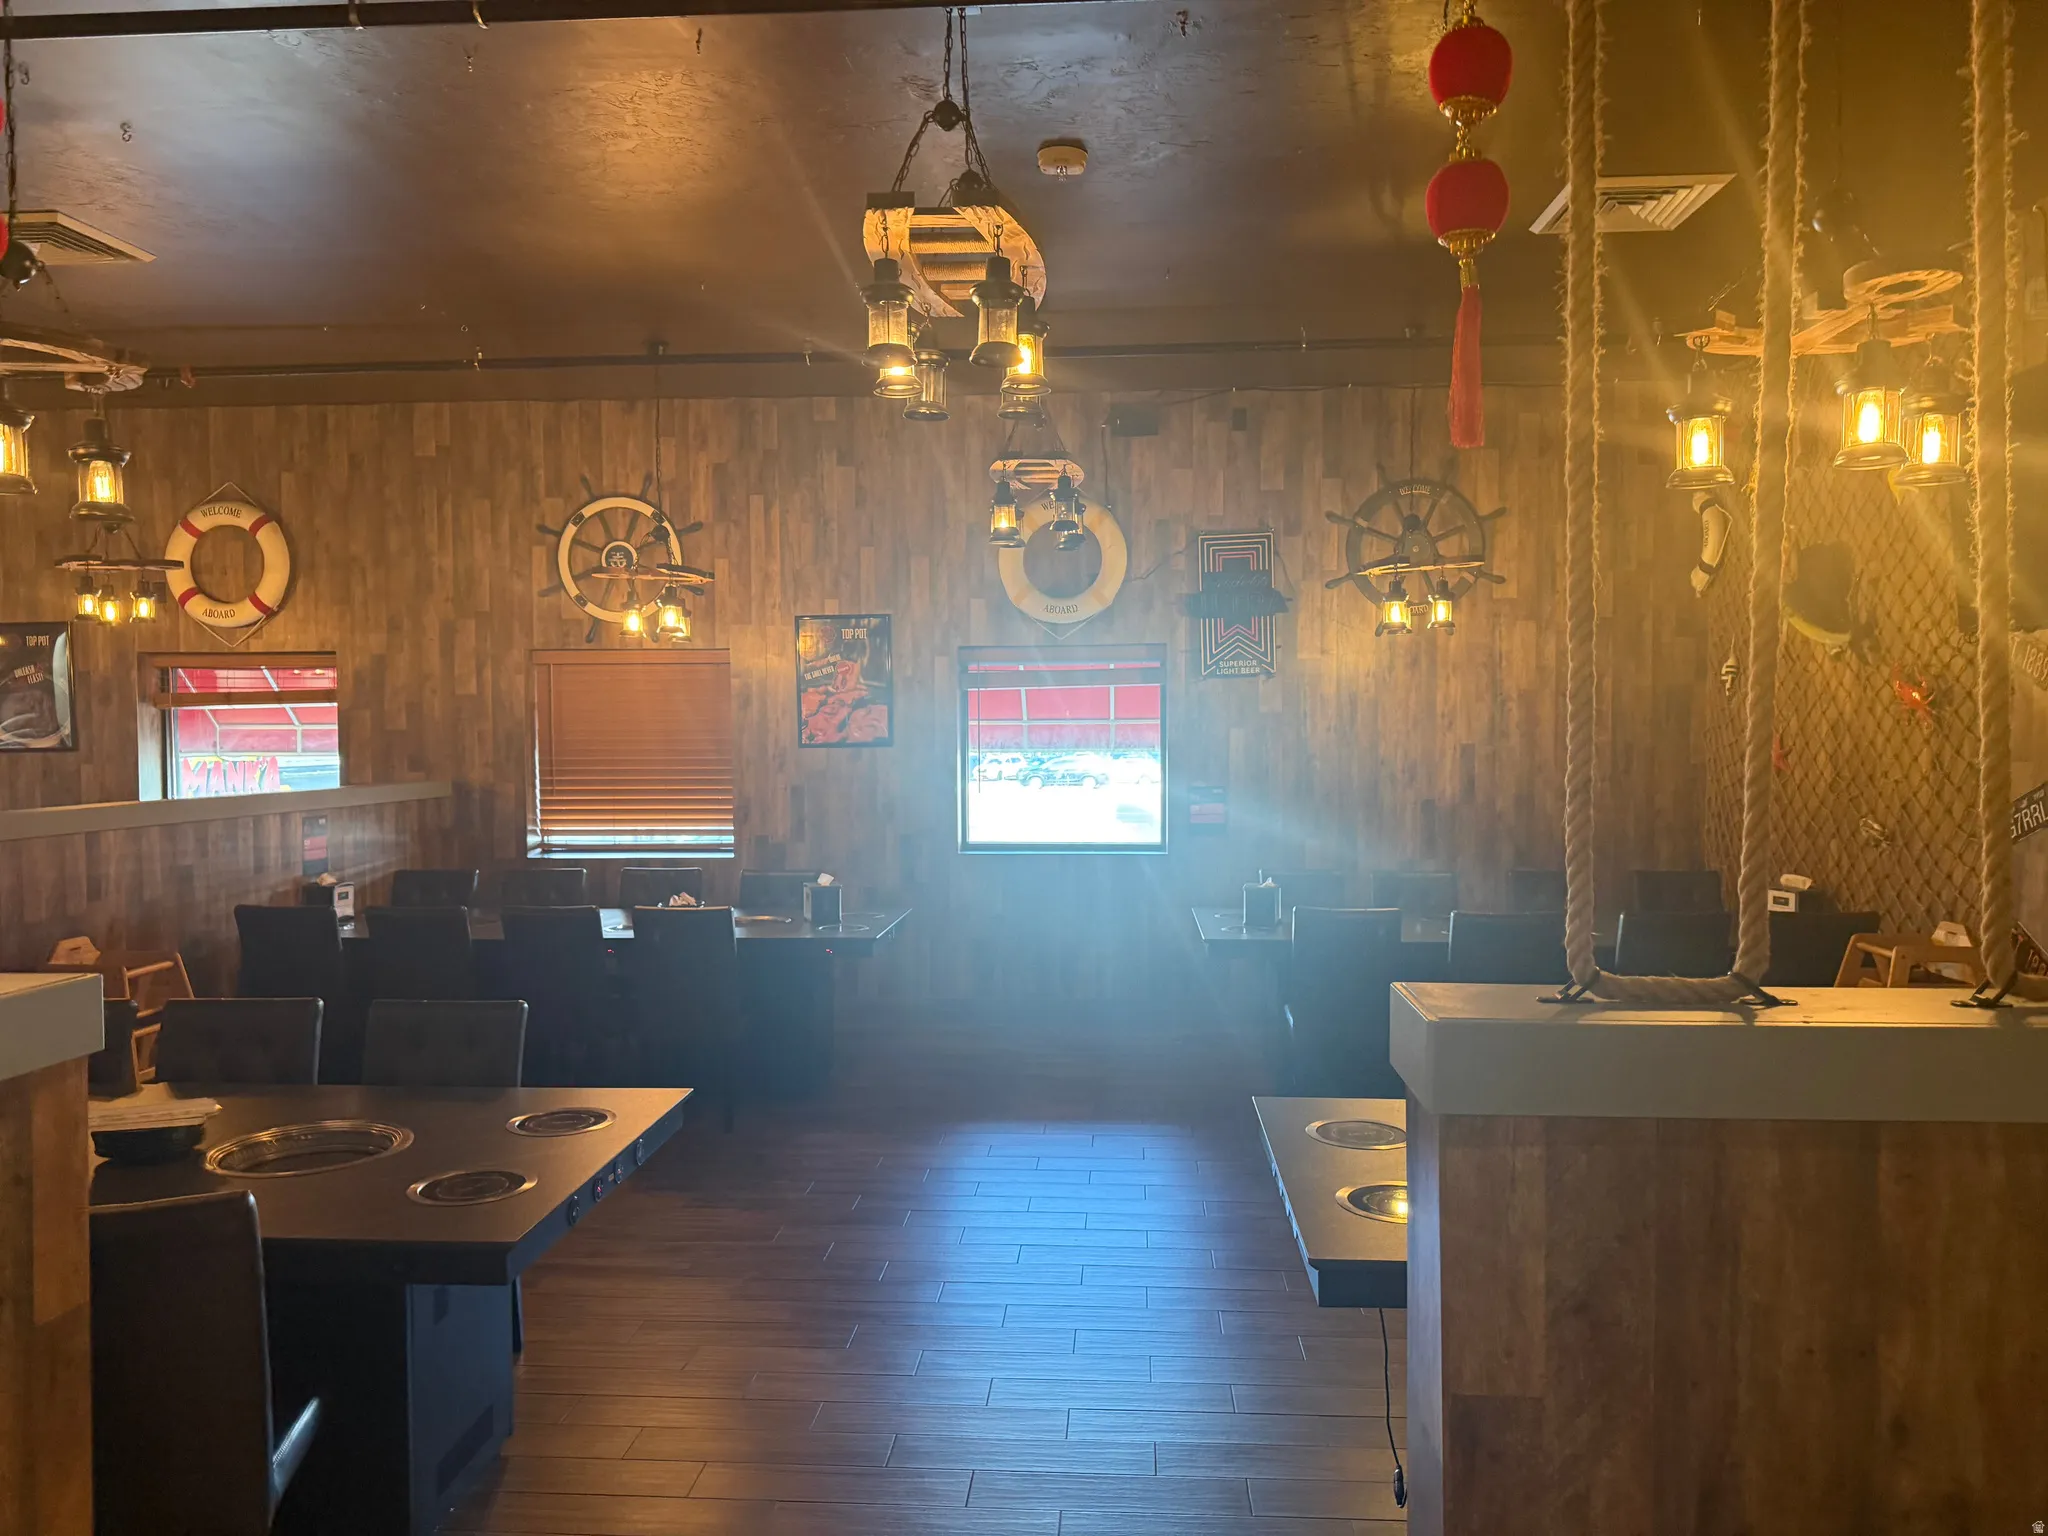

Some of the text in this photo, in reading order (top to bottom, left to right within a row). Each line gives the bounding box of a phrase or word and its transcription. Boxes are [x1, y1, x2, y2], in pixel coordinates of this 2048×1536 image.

[200, 505, 242, 518] WELCOME
[202, 607, 236, 619] ABOARD
[1043, 604, 1078, 615] ABOARD
[841, 628, 867, 639] TOP POT
[26, 635, 50, 647] TOP POT
[1219, 659, 1258, 668] SUPERIOR
[1240, 667, 1260, 675] BEER
